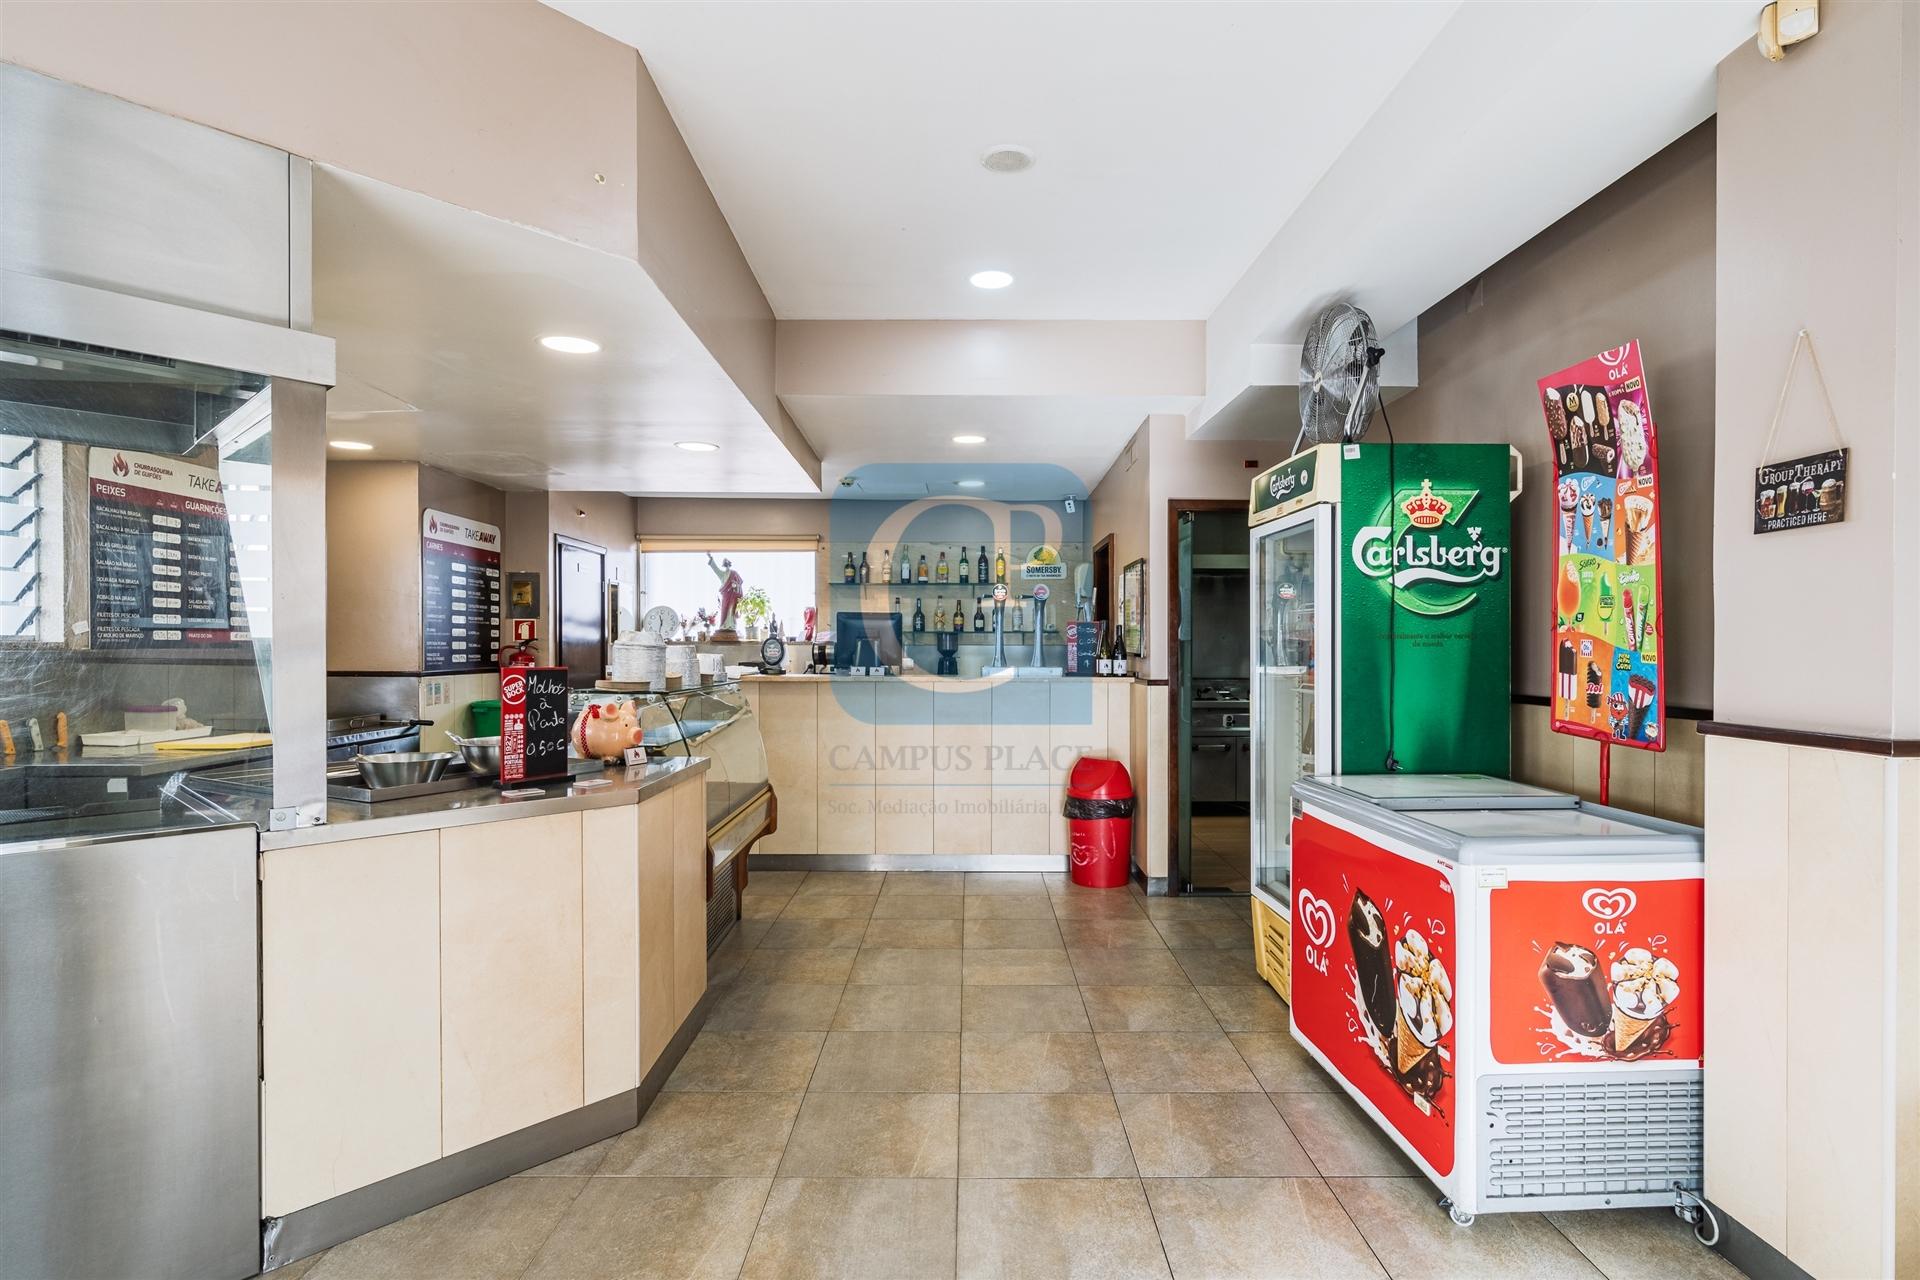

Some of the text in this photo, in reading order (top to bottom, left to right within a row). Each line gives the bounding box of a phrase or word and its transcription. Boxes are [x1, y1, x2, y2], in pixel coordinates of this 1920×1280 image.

[1608, 362, 1628, 381] OLÁ
[1626, 379, 1640, 390] NOVO
[134, 462, 173, 476] CHURRASQUEIRA
[142, 471, 162, 481] GUIFÕES
[1638, 477, 1653, 486] NOVO
[96, 484, 126, 497] PEIXES
[1269, 472, 1295, 499] Carlsberg
[1768, 511, 1828, 530] PRACTICED HERE
[465, 528, 497, 545] TAKEAWAY
[426, 541, 444, 551] CARNES
[1352, 526, 1502, 589] Carlsberg
[1026, 565, 1062, 574] SOMERSBY
[1642, 654, 1657, 662] NOVO
[504, 681, 523, 692] SUPER
[527, 675, 565, 695] Molhos
[506, 687, 525, 699] BOCK
[1594, 918, 1627, 935] OLÁ
[1305, 943, 1329, 977] OLÁ
